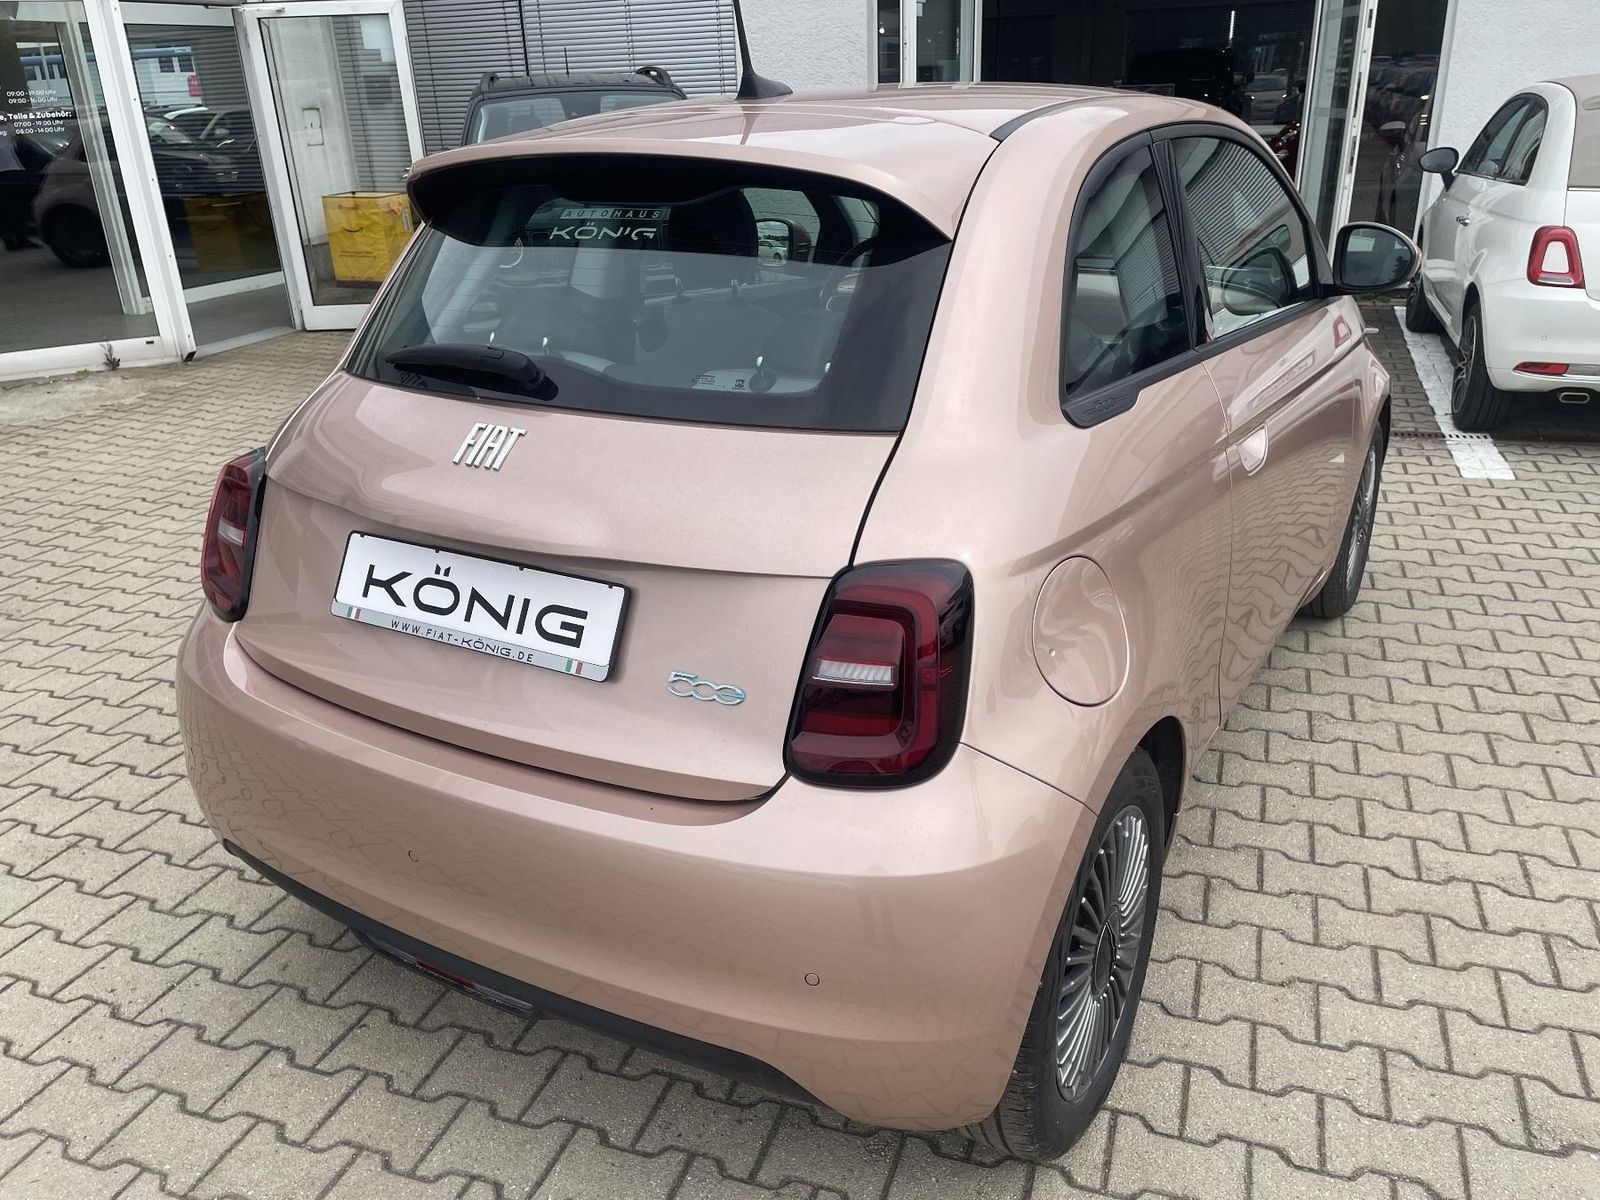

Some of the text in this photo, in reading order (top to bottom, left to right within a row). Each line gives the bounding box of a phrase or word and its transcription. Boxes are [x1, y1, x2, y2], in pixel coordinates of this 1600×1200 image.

[36, 110, 72, 119] Zubehör:
[564, 209, 661, 219] AUTOHAUS
[549, 222, 657, 241] KÖNIG
[452, 422, 527, 471] FIAT
[362, 563, 588, 648] KÖNIG
[390, 619, 534, 663] WWW.FIAT-KÖNIG.DE
